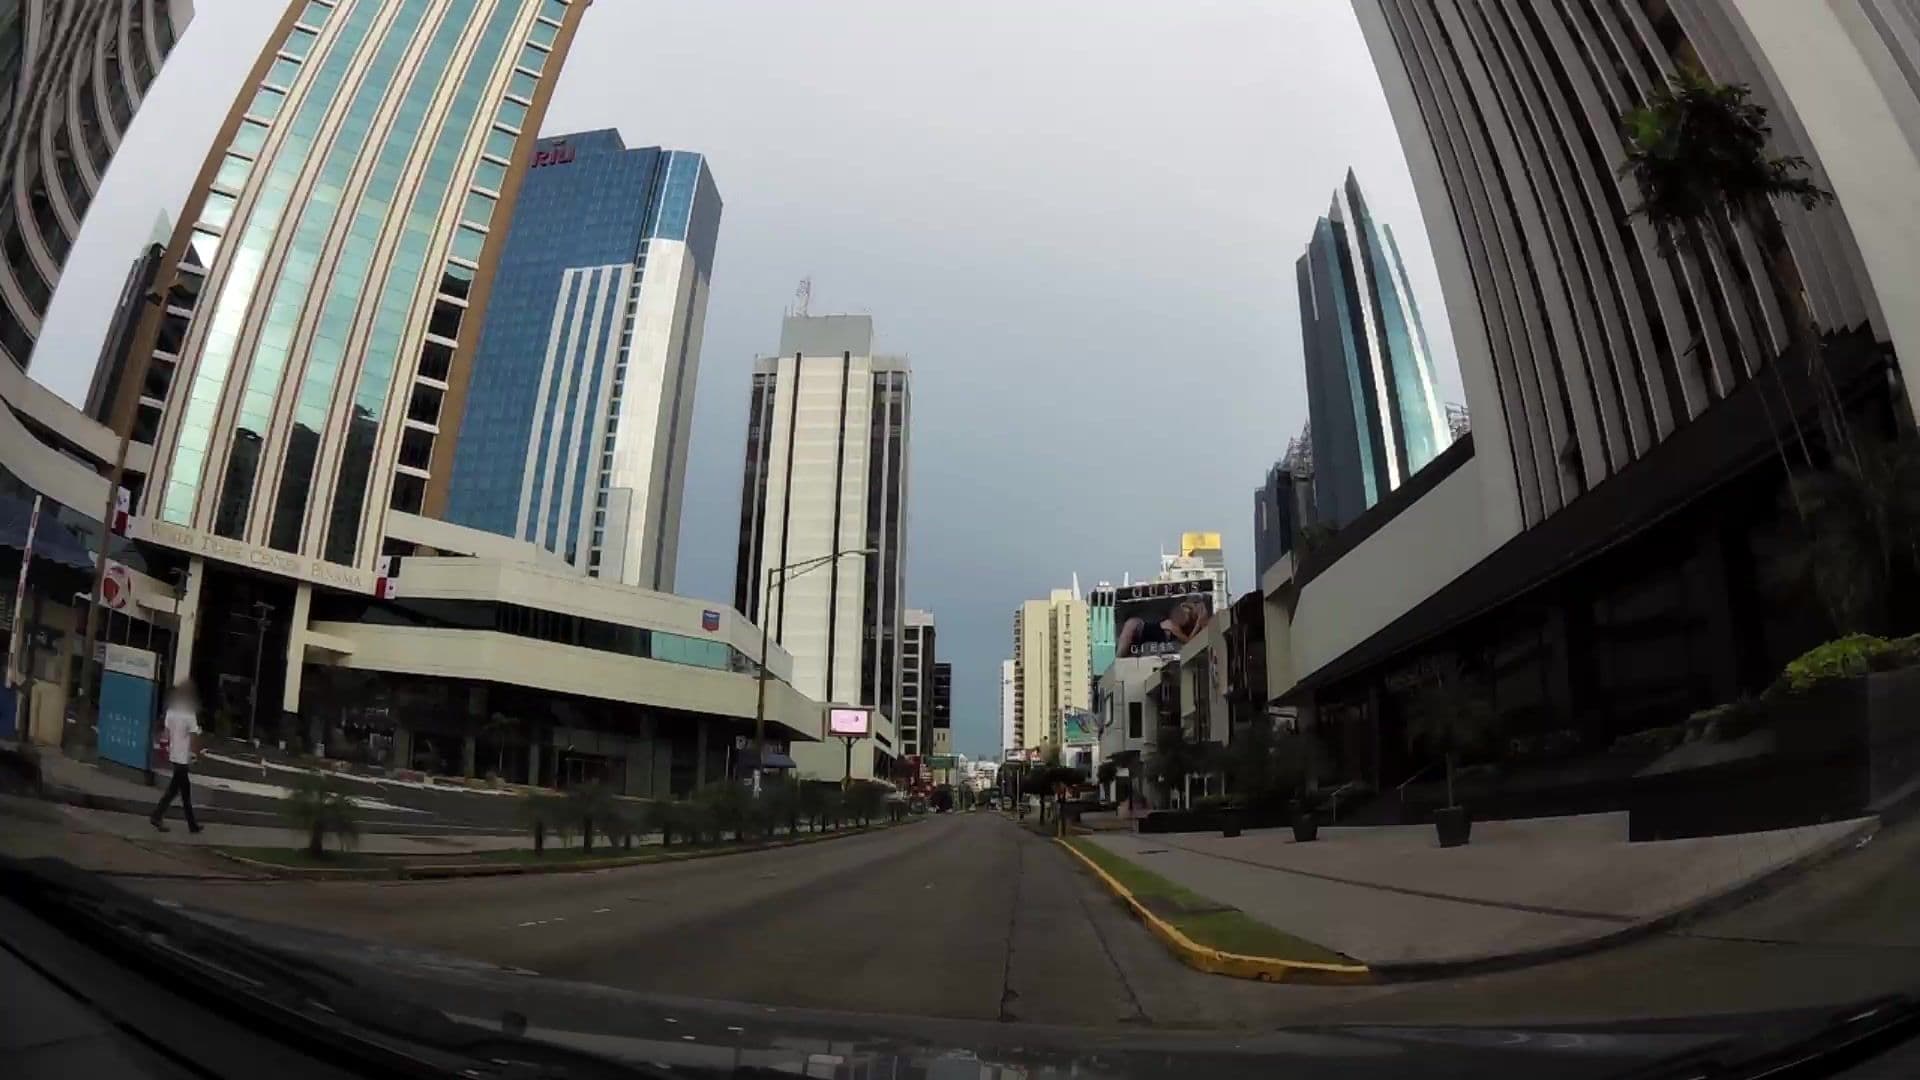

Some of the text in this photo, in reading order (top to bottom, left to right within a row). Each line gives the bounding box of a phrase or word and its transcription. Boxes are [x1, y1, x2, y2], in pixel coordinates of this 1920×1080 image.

[531, 145, 576, 168] RIU
[151, 522, 192, 545] WLD
[1132, 582, 1200, 598] GUESS
